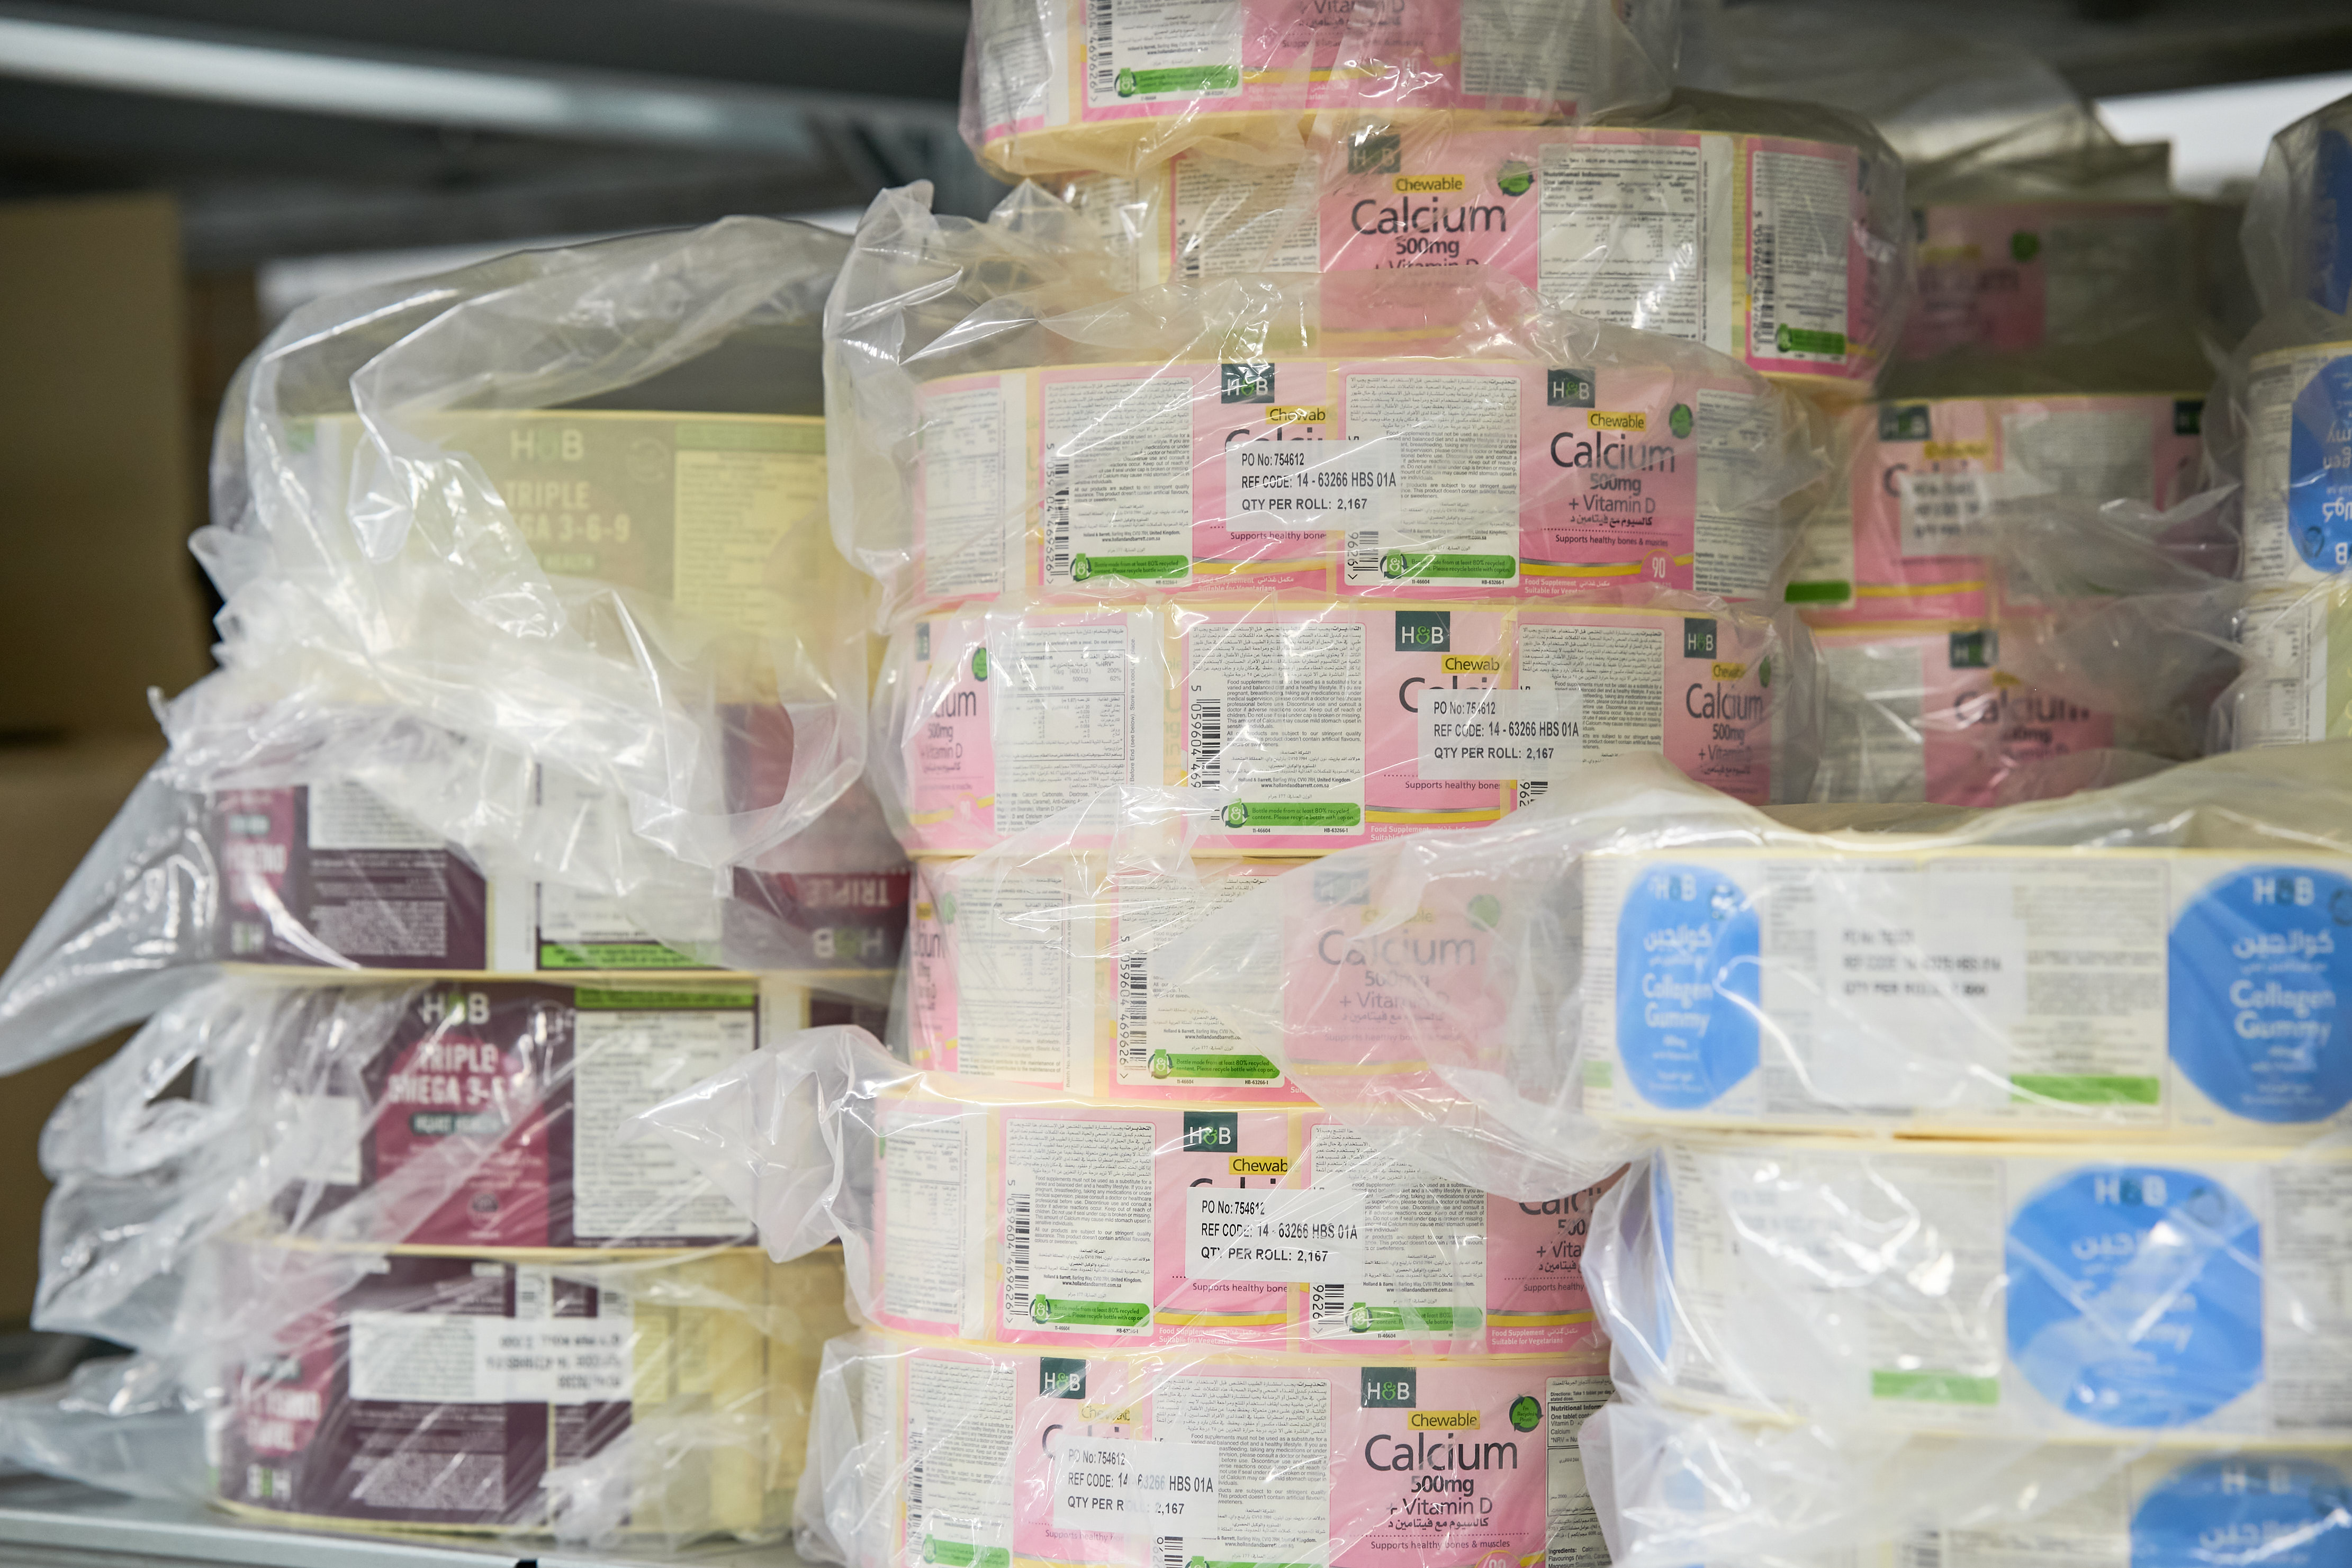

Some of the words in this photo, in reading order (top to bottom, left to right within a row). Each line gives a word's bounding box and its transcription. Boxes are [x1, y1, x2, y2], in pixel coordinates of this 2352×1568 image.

[1395, 177, 1462, 191] Chewable
[1351, 197, 1506, 234] Calcium
[1395, 237, 1460, 258] 500mg
[1227, 380, 1268, 395] H&B
[1553, 381, 1589, 399] H&B
[1270, 408, 1326, 421] Chewab
[1591, 413, 1644, 428] Chewable
[1551, 432, 1675, 472] Calcium
[1242, 454, 1255, 466] PO
[1242, 476, 1259, 488] REF
[1263, 475, 1292, 488] CODE:
[1297, 474, 1309, 486] 14
[1318, 473, 1348, 487] 63266
[1351, 472, 1373, 487] HBS
[1377, 472, 1396, 487] 01A
[1591, 473, 1641, 495] 500mg
[504, 480, 591, 511] TRIPLE
[1242, 499, 1266, 511] QTY
[1269, 499, 1293, 509] PER
[1296, 499, 1331, 509] ROLL:
[1337, 499, 1367, 511] 2,167
[1583, 497, 1642, 512] Vitamin
[1645, 498, 1655, 512] D
[1577, 515, 1606, 525] فيتامين
[1608, 517, 1620, 527] مع
[1622, 516, 1652, 527] كالسيوم
[559, 515, 630, 542] 3-6-9
[1231, 531, 1267, 540] Supports
[1269, 531, 1301, 540] healthy
[1556, 535, 1587, 545] Supports
[1590, 536, 1615, 546] healthy
[1617, 537, 1637, 545] bones
[1639, 538, 1643, 546] &
[1645, 538, 1668, 547] muscles
[1652, 557, 1665, 577] 90
[1401, 626, 1444, 644] H&B
[1688, 635, 1714, 651] H&B
[1446, 658, 1500, 672] Chewab
[1434, 702, 1446, 714] PO
[1686, 682, 1763, 719] Calcium
[1434, 724, 1451, 737] REF
[1455, 724, 1484, 737] CODE:
[1489, 723, 1500, 736] 14
[1509, 723, 1536, 736] 63266
[1539, 723, 1559, 737] HBS
[1561, 723, 1579, 737] 01A
[1435, 747, 1458, 760] QTY
[1462, 747, 1484, 759] PER
[1488, 747, 1521, 758] ROLL:
[1526, 747, 1554, 760] 2,167
[1405, 781, 1442, 790] Supports
[1445, 781, 1475, 791] healthy
[1319, 929, 1476, 966] Calcium
[1643, 974, 1714, 1008] Collagen
[1645, 1003, 1710, 1035] Gummy
[1189, 1126, 1231, 1145] H&B
[1233, 1159, 1287, 1172] Chewab
[1202, 1201, 1215, 1213] PO
[1202, 1223, 1220, 1237] REF
[1257, 1224, 1269, 1237] 14
[1279, 1223, 1309, 1238] 63266
[1312, 1224, 1335, 1239] HBS
[1338, 1224, 1357, 1239] 01A
[1228, 1248, 1252, 1259] PER
[1256, 1249, 1292, 1261] ROLL:
[1297, 1250, 1328, 1264] 2,167
[1193, 1284, 1229, 1293] Supports
[1232, 1285, 1263, 1294] healthy
[1524, 1284, 1555, 1293] Supports
[1557, 1283, 1584, 1293] healthy
[1045, 1371, 1080, 1391] H&B
[1367, 1382, 1409, 1400] H&B
[1412, 1414, 1477, 1427] Chewable
[1365, 1433, 1517, 1471] Calcium
[1068, 1473, 1083, 1486] REF
[1086, 1473, 1114, 1488] CODE:
[1169, 1476, 1190, 1491] HBS
[1194, 1477, 1213, 1492] 01A
[1411, 1476, 1474, 1497] 500mg
[1068, 1497, 1088, 1508] QTY
[1092, 1497, 1112, 1510] PER
[1402, 1497, 1474, 1514] Vitamin
[1480, 1498, 1492, 1513] D
[1397, 1517, 1432, 1531] فيتامين
[1435, 1517, 1448, 1531] مع
[1450, 1517, 1489, 1531] كالسيوم
[1371, 1541, 1409, 1551] Supports
[1412, 1541, 1441, 1551] healthy
[1445, 1540, 1468, 1549] bones
[1481, 1539, 1510, 1548] muscles
